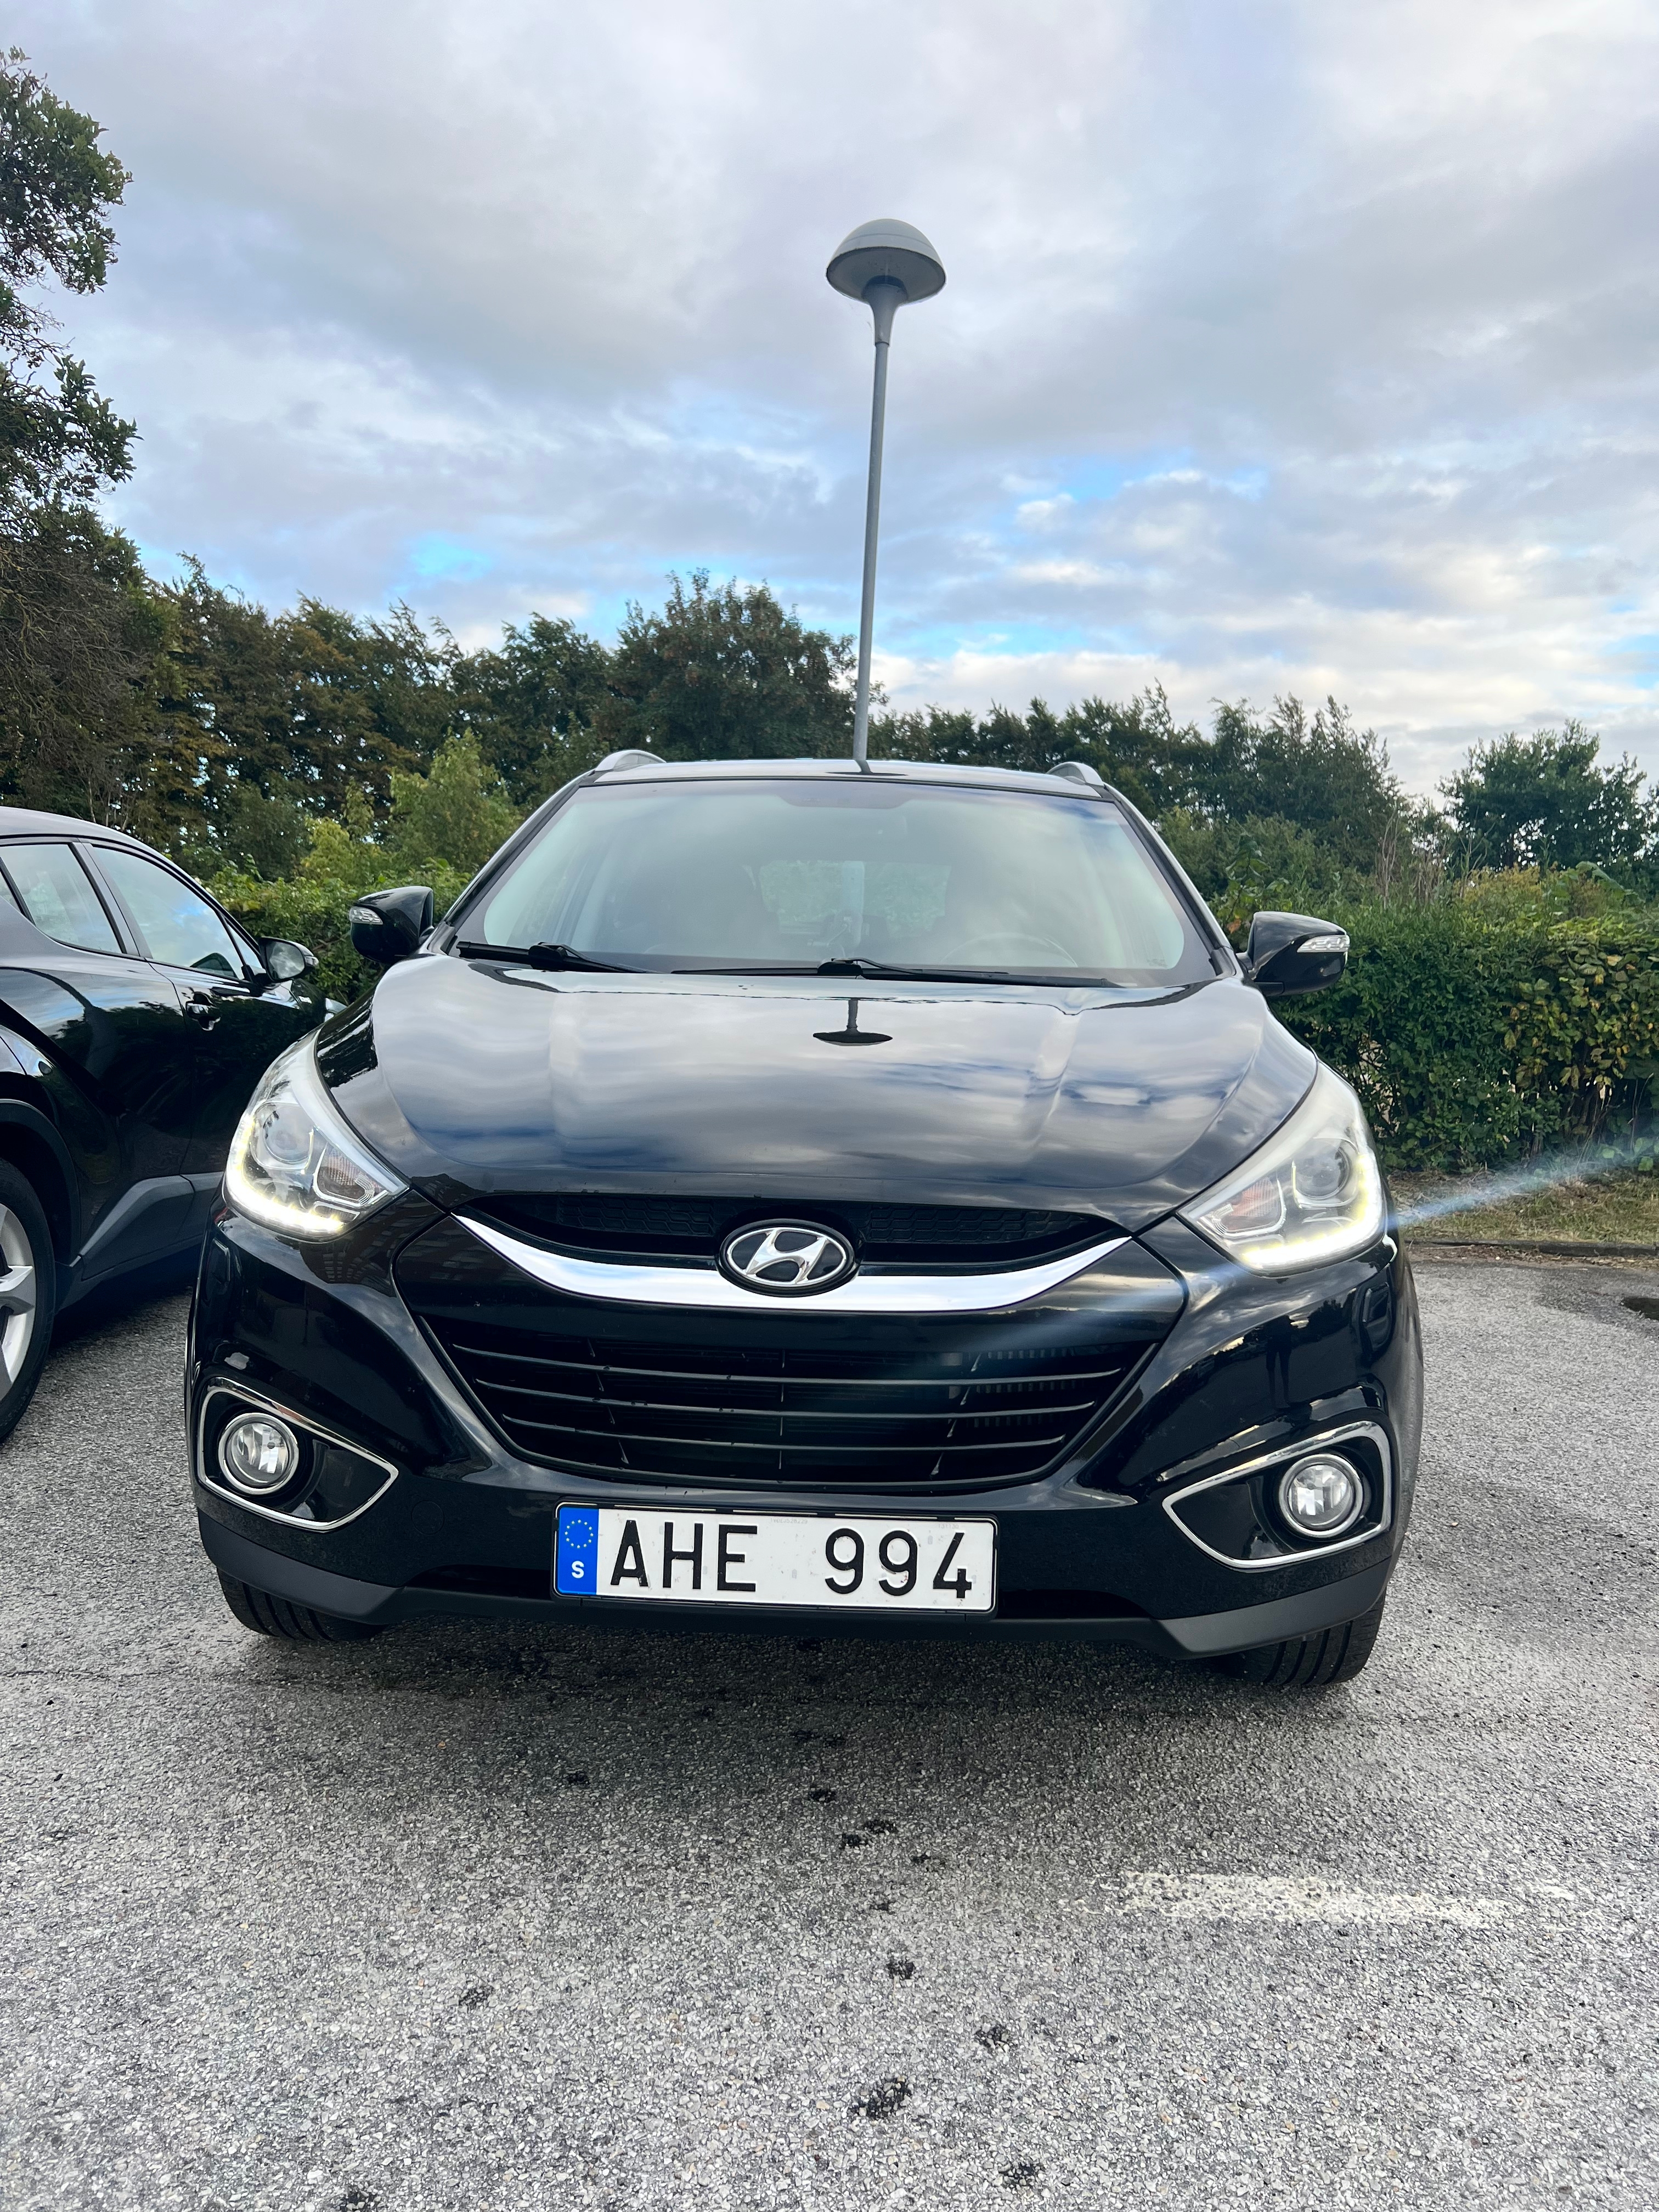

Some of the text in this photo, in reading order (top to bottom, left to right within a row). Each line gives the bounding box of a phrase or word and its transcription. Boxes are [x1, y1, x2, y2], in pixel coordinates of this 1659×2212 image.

[572, 1561, 584, 1578] S
[610, 1520, 972, 1599] AHE 994
